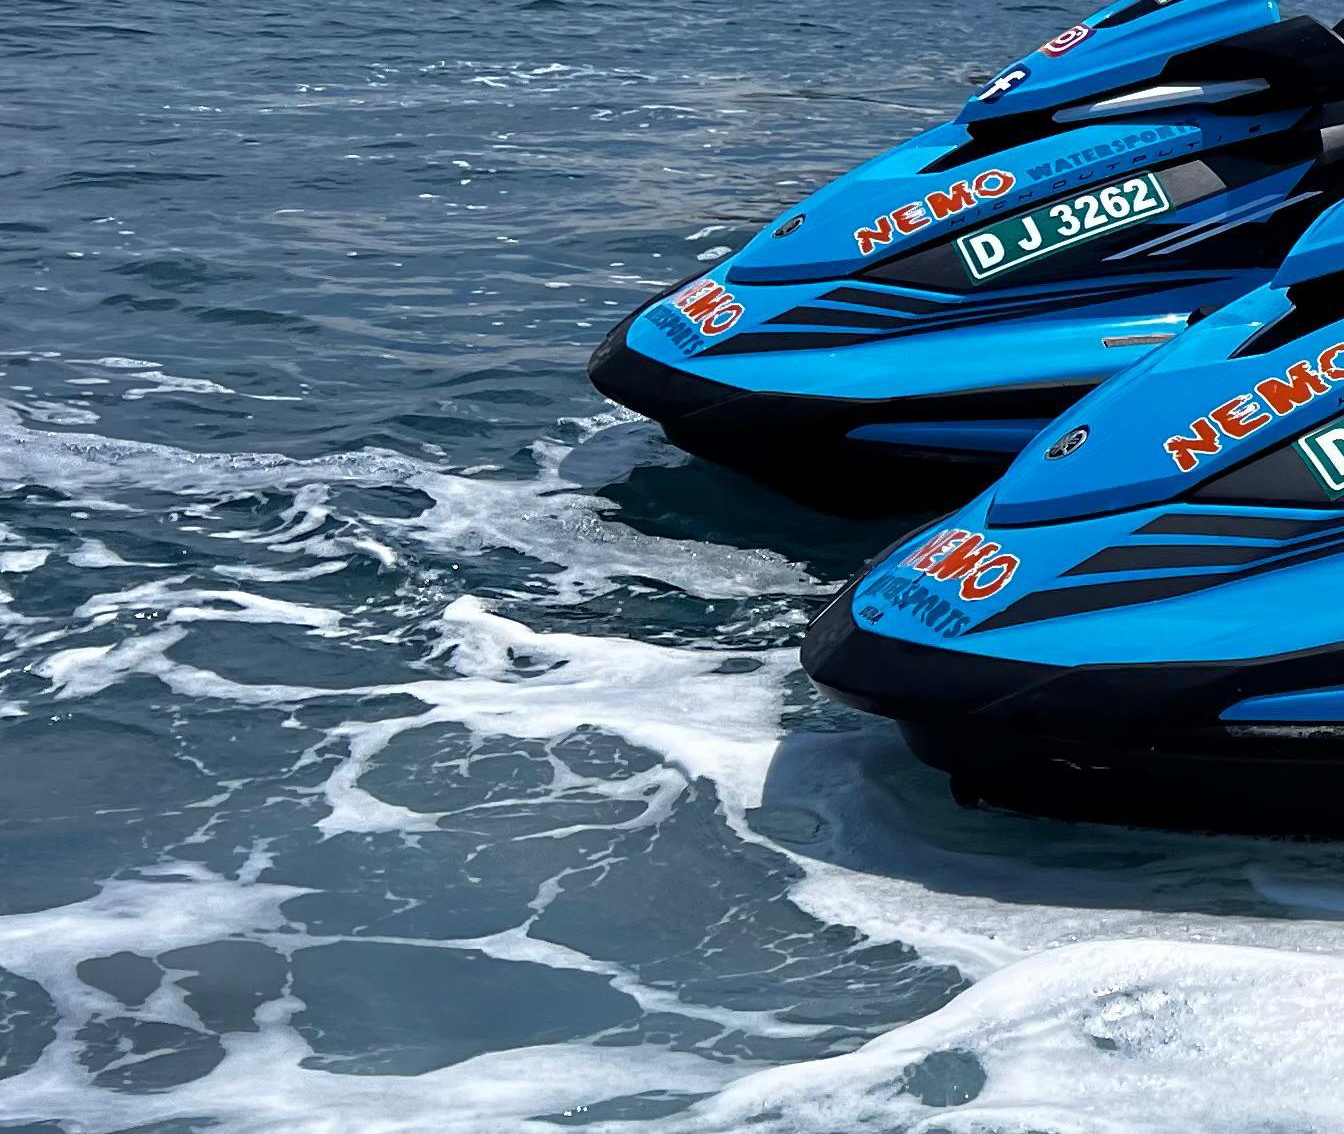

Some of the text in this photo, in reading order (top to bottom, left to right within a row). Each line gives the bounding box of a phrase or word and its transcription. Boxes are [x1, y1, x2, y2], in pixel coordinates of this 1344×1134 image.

[1052, 141, 1200, 189] OUTPUT
[853, 169, 1016, 255] NEMO
[968, 177, 1158, 270] D J 3262
[672, 278, 745, 337] EMO
